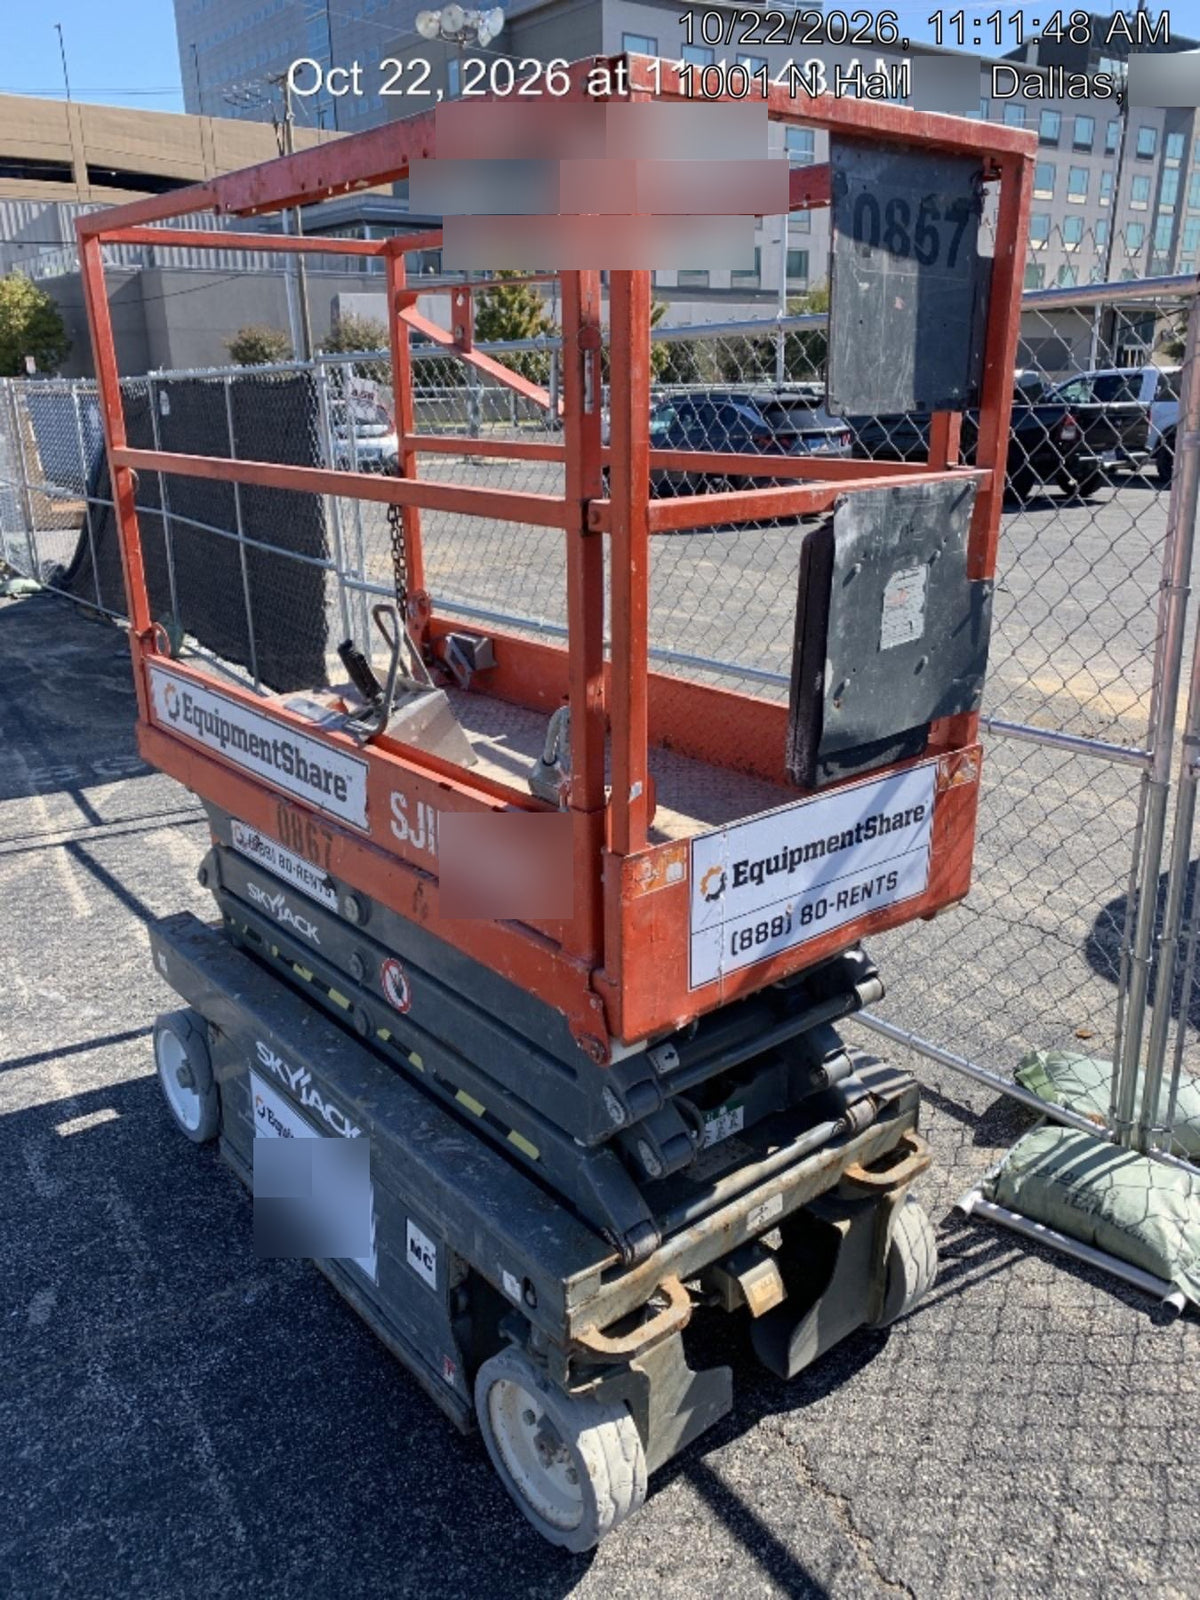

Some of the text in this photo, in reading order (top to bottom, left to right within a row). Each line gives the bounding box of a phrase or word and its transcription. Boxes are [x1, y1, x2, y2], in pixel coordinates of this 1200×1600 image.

[181, 692, 348, 802] EquipmentShare
[732, 805, 925, 888] EquipmentShare
[731, 870, 898, 956] (888) 80-RENTS
